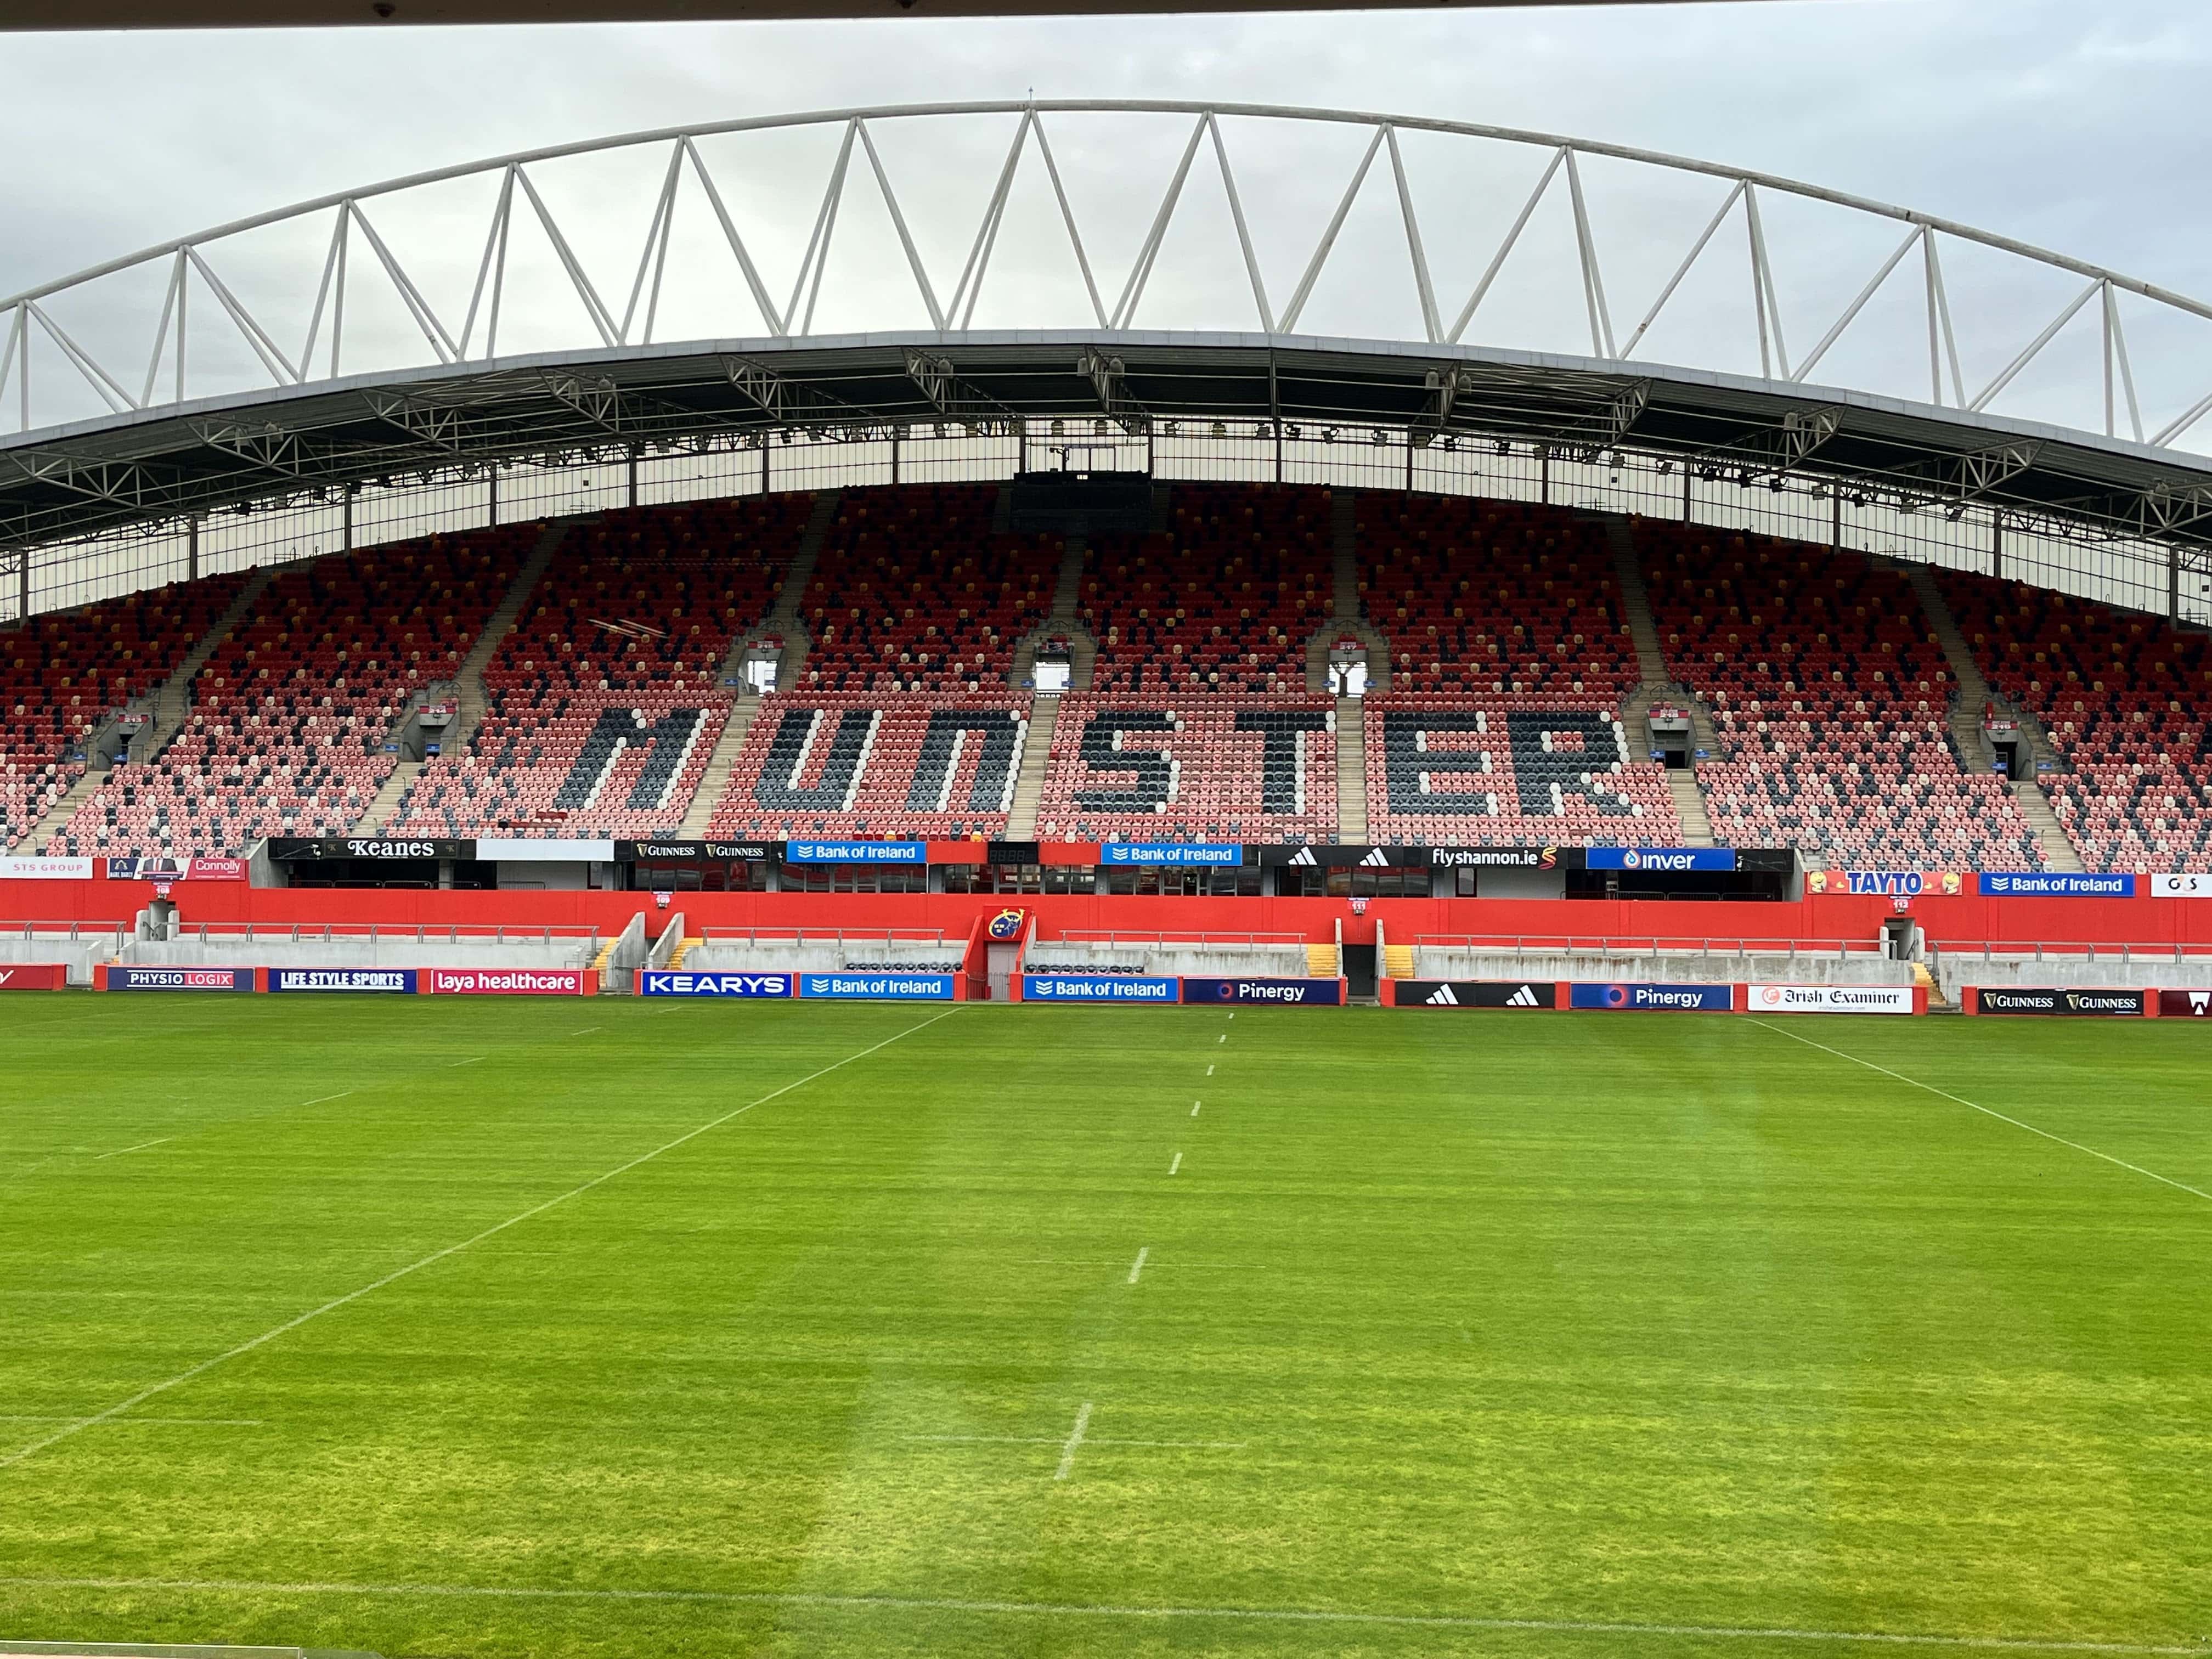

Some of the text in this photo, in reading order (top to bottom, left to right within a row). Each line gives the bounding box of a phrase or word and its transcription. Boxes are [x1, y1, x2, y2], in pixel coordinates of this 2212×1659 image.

[554, 708, 1644, 815] MUNSTER
[347, 840, 435, 856] Keanes
[647, 845, 695, 856] GUINNESS
[715, 846, 764, 857] GUINNESS
[816, 846, 915, 859] Bank of Ireland
[1131, 848, 1232, 861] Bank of Ireland
[1432, 848, 1538, 868] flyshannon.ie
[195, 860, 241, 873] Connolly
[1846, 871, 1924, 894] TAYTO
[2012, 878, 2123, 891] Bank of Ireland
[131, 973, 230, 985] PHYSIO LOGIX
[281, 972, 404, 986] LIFE STYLE SPORTS
[437, 972, 575, 992] laya healthcare
[650, 975, 785, 993] KEARYS
[832, 979, 941, 994] Bank of Ireland
[1056, 981, 1166, 997] Bank of Ireland
[1239, 983, 1305, 1001] Pinergy
[1785, 989, 1900, 1004] Irish Examiner
[1635, 988, 1702, 1008] Pinergy
[1996, 995, 2054, 1008] GUINNESS
[2079, 995, 2137, 1009] GUINNESS
